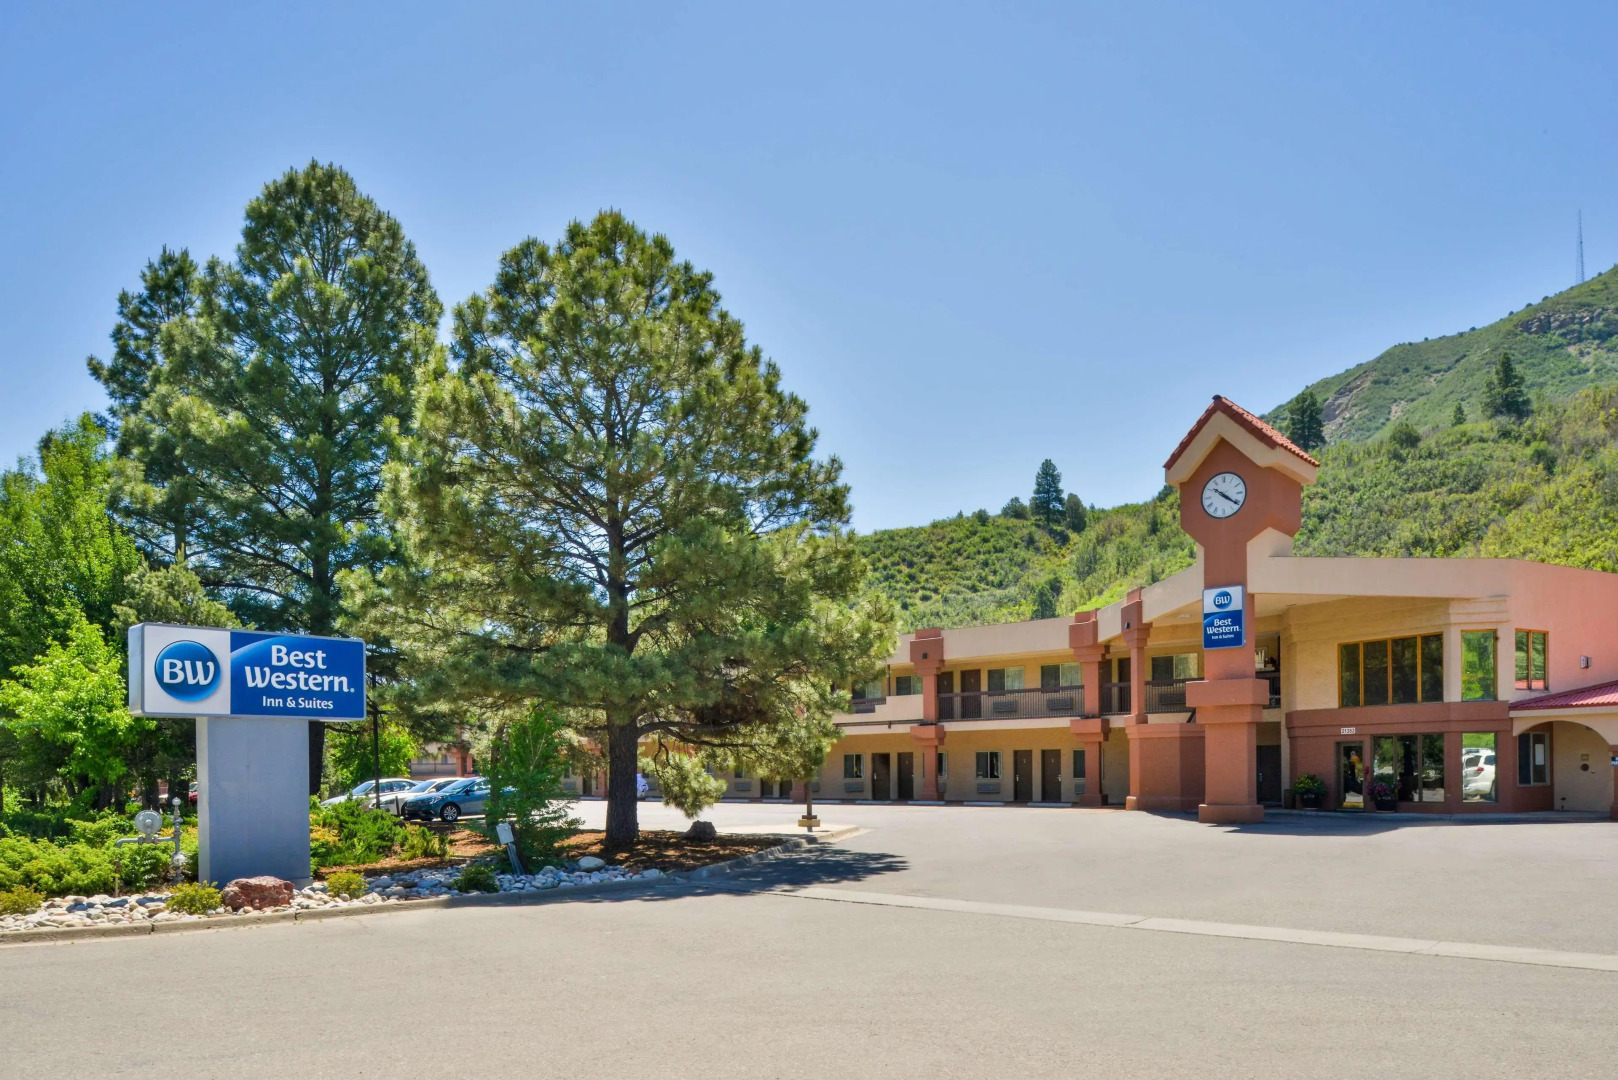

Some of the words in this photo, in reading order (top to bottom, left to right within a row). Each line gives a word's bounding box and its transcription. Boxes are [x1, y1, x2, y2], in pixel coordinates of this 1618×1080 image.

[1215, 596, 1230, 605] BW
[1214, 618, 1231, 627] Best
[1206, 625, 1239, 635] Western
[271, 645, 327, 669] Best
[163, 659, 214, 686] BW
[262, 696, 283, 708] Inn
[286, 697, 297, 708] &
[298, 697, 334, 710] Suites
